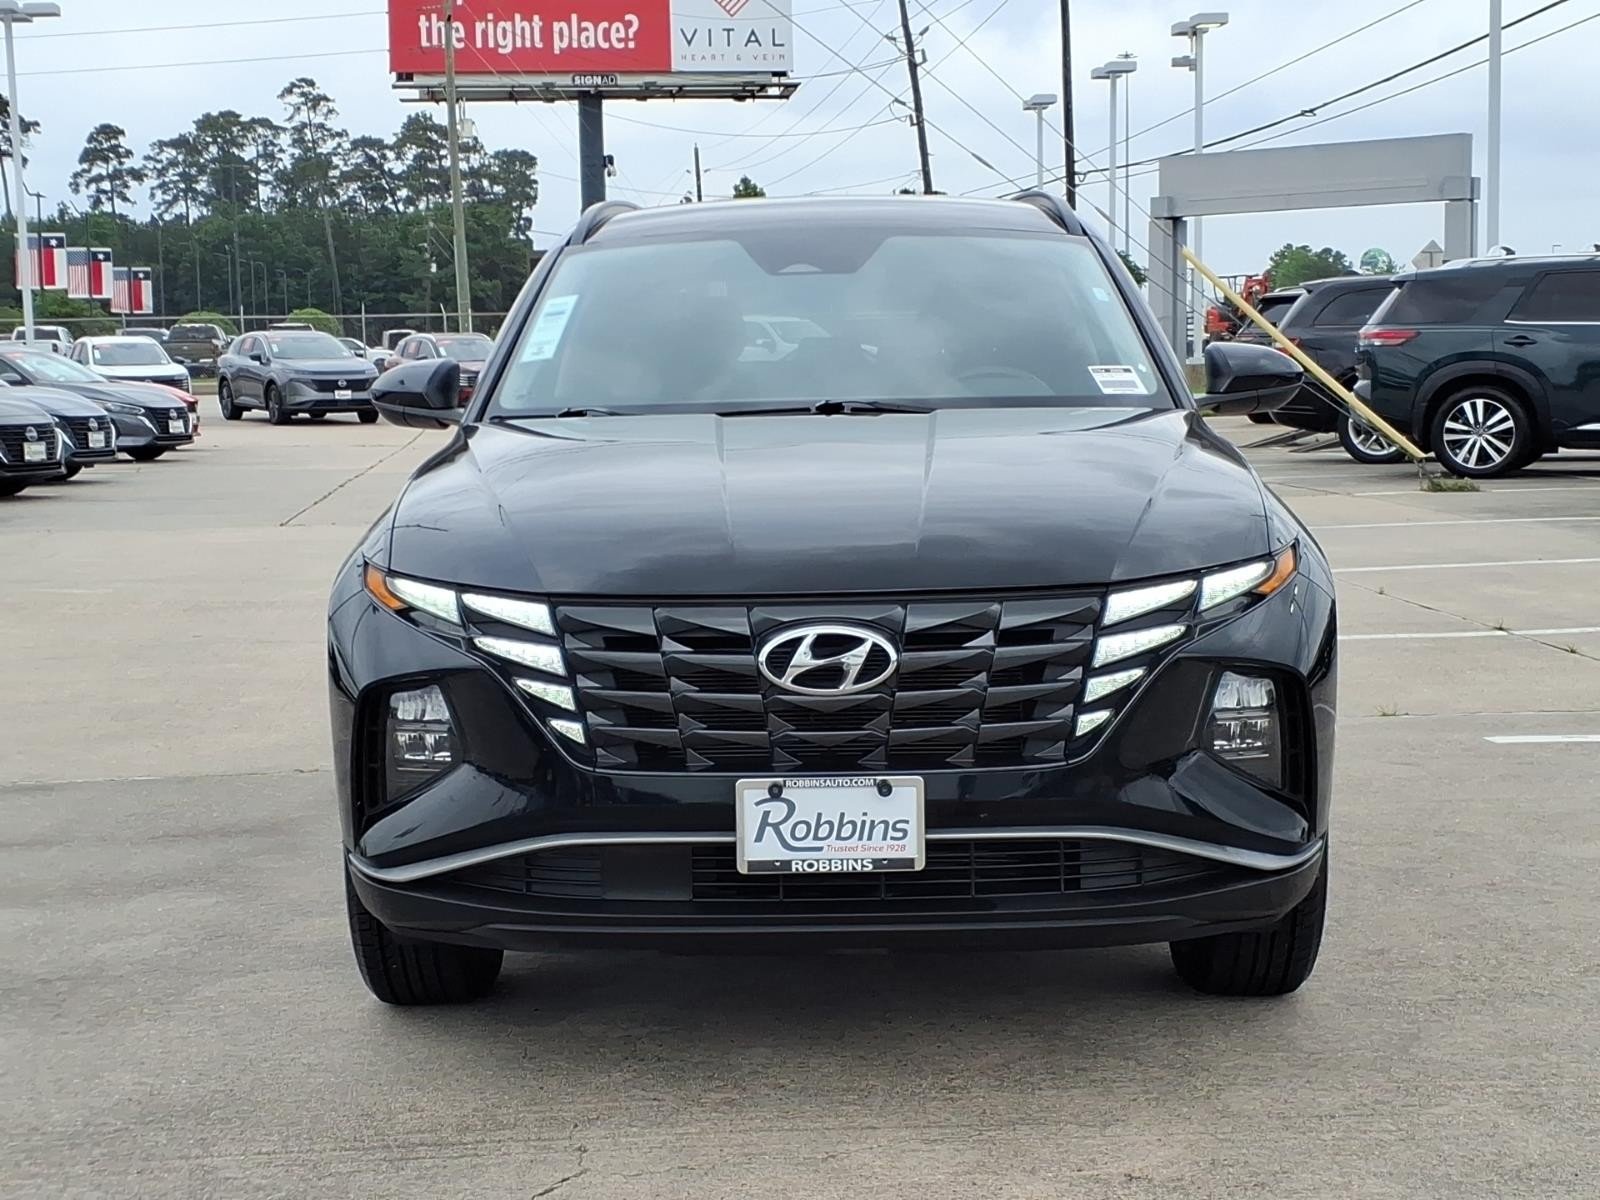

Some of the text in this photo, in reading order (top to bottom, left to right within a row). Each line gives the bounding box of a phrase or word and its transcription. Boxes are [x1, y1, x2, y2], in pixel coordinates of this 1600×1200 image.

[418, 13, 640, 54] the right place?
[680, 28, 785, 47] VITAL
[785, 779, 874, 788] ROBBINSAUTO.COM
[754, 797, 910, 852] Robbins
[826, 844, 907, 852] Trusted Since 1928
[791, 859, 873, 872] ROBBINS
